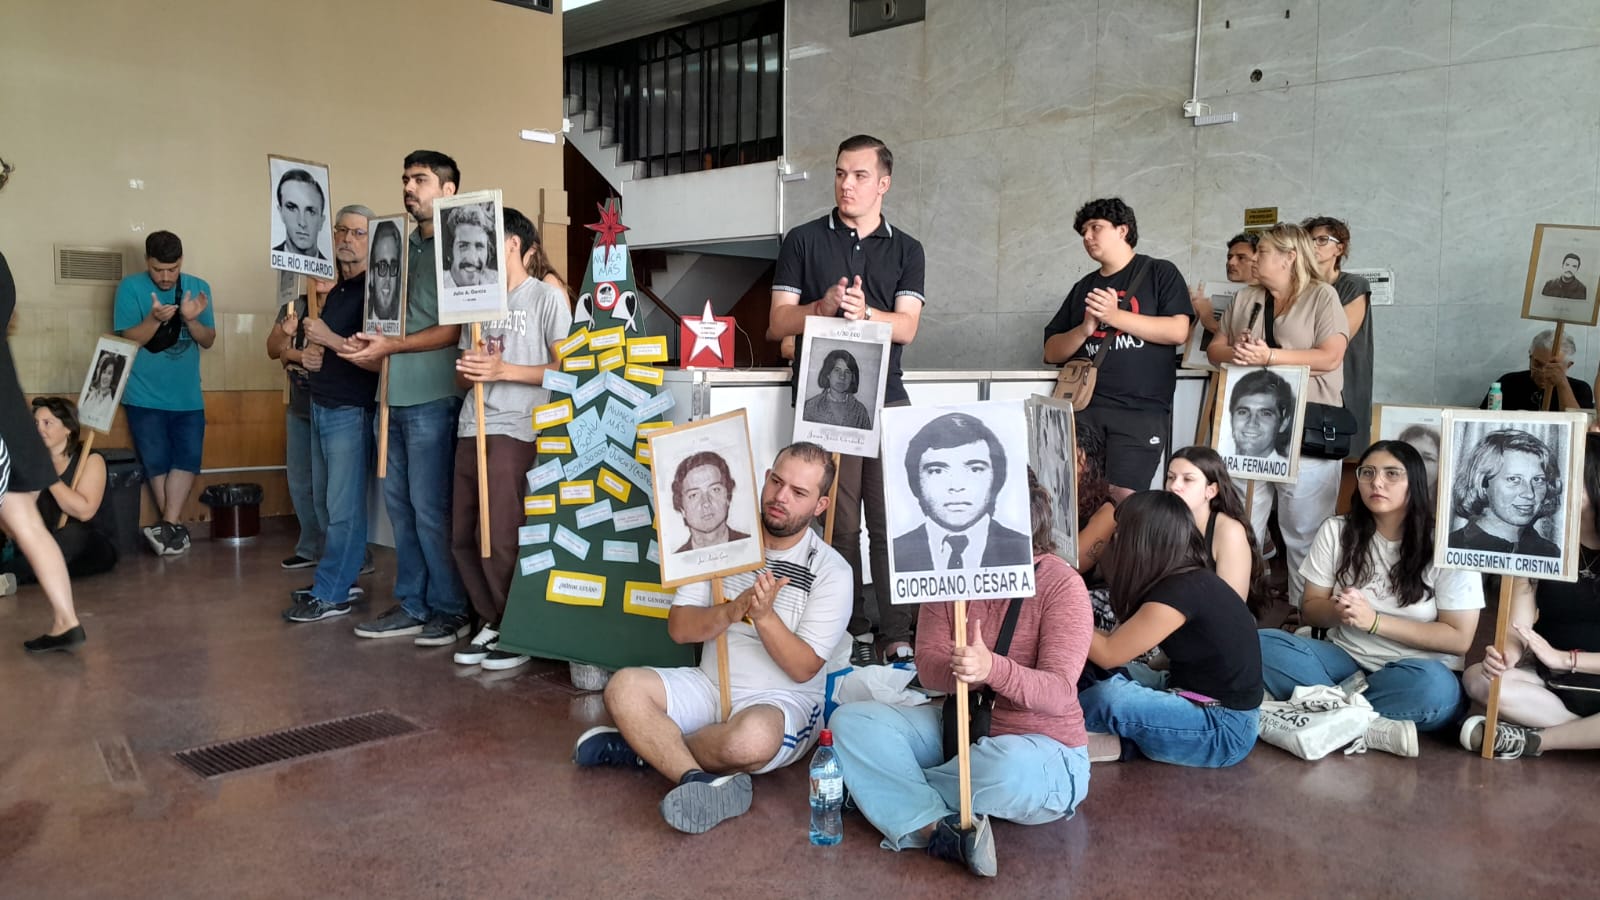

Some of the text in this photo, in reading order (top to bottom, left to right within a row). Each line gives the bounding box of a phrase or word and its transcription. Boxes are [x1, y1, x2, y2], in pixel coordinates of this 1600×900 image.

[271, 254, 333, 276] DEL RÍO, RICARDO
[608, 404, 635, 424] NUNCA
[1220, 456, 1288, 476] ARA, FERNANDO
[1515, 557, 1560, 575] CRISTINA
[896, 568, 1034, 598] GIORDANO, CÉSAR A.
